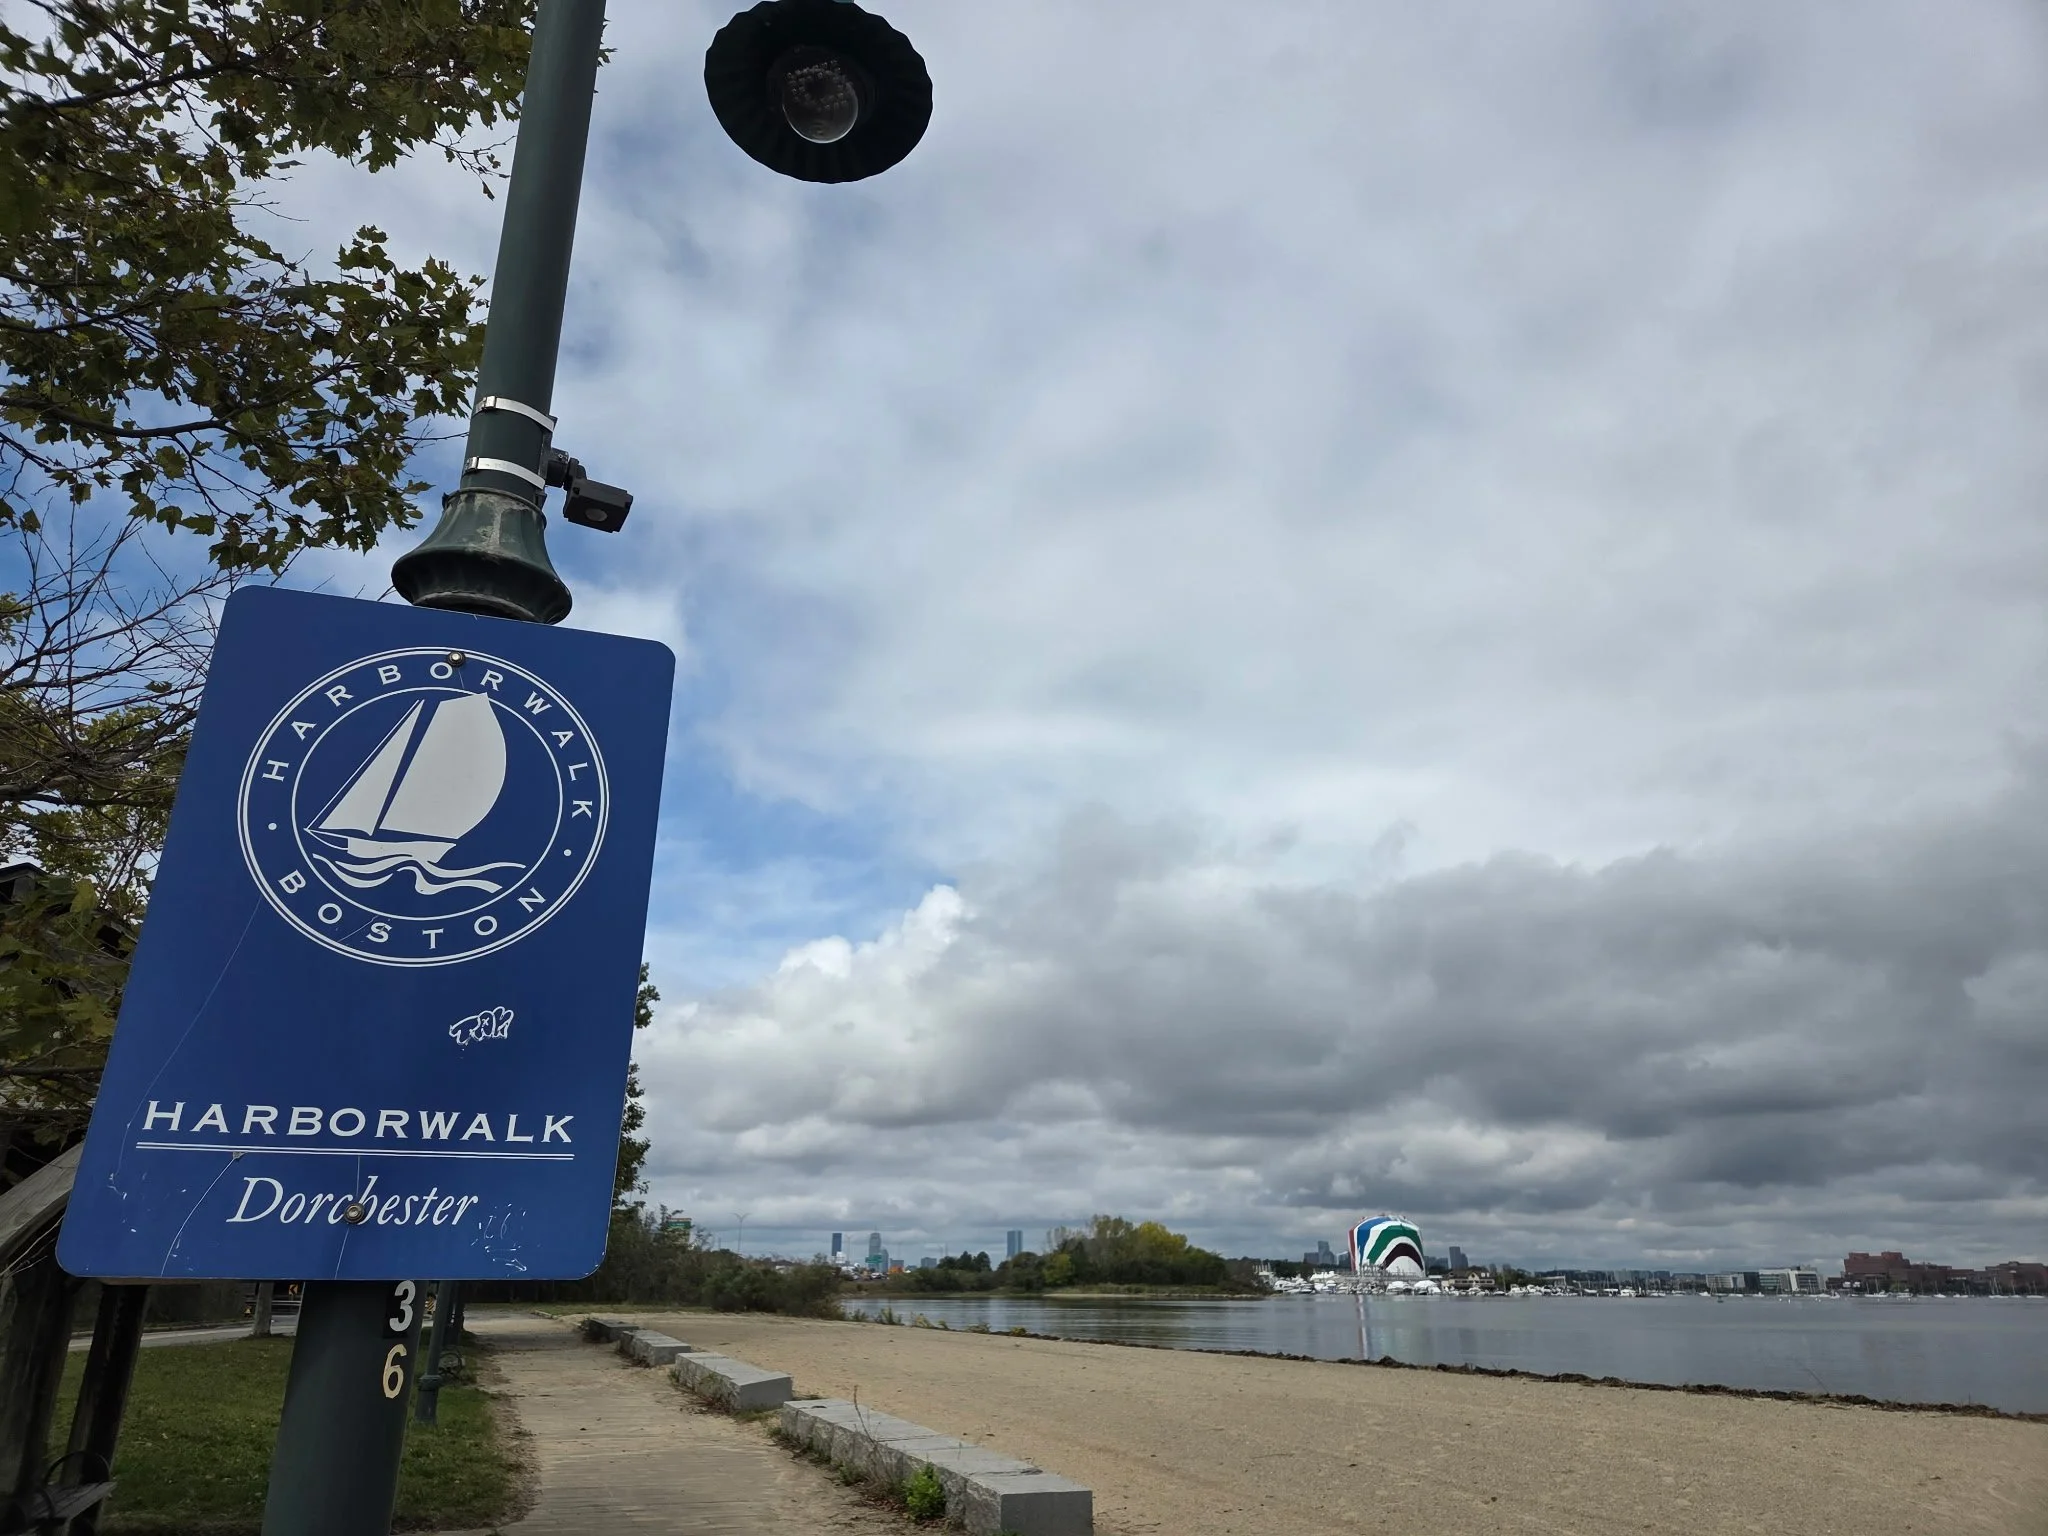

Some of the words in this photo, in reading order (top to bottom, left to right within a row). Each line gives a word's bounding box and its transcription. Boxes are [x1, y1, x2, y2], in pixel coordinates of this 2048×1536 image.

[262, 661, 593, 818] HARBORWALK
[279, 870, 547, 950] BOSTON
[142, 1100, 575, 1143] HARBORWALK
[226, 1175, 479, 1226] Dorchester
